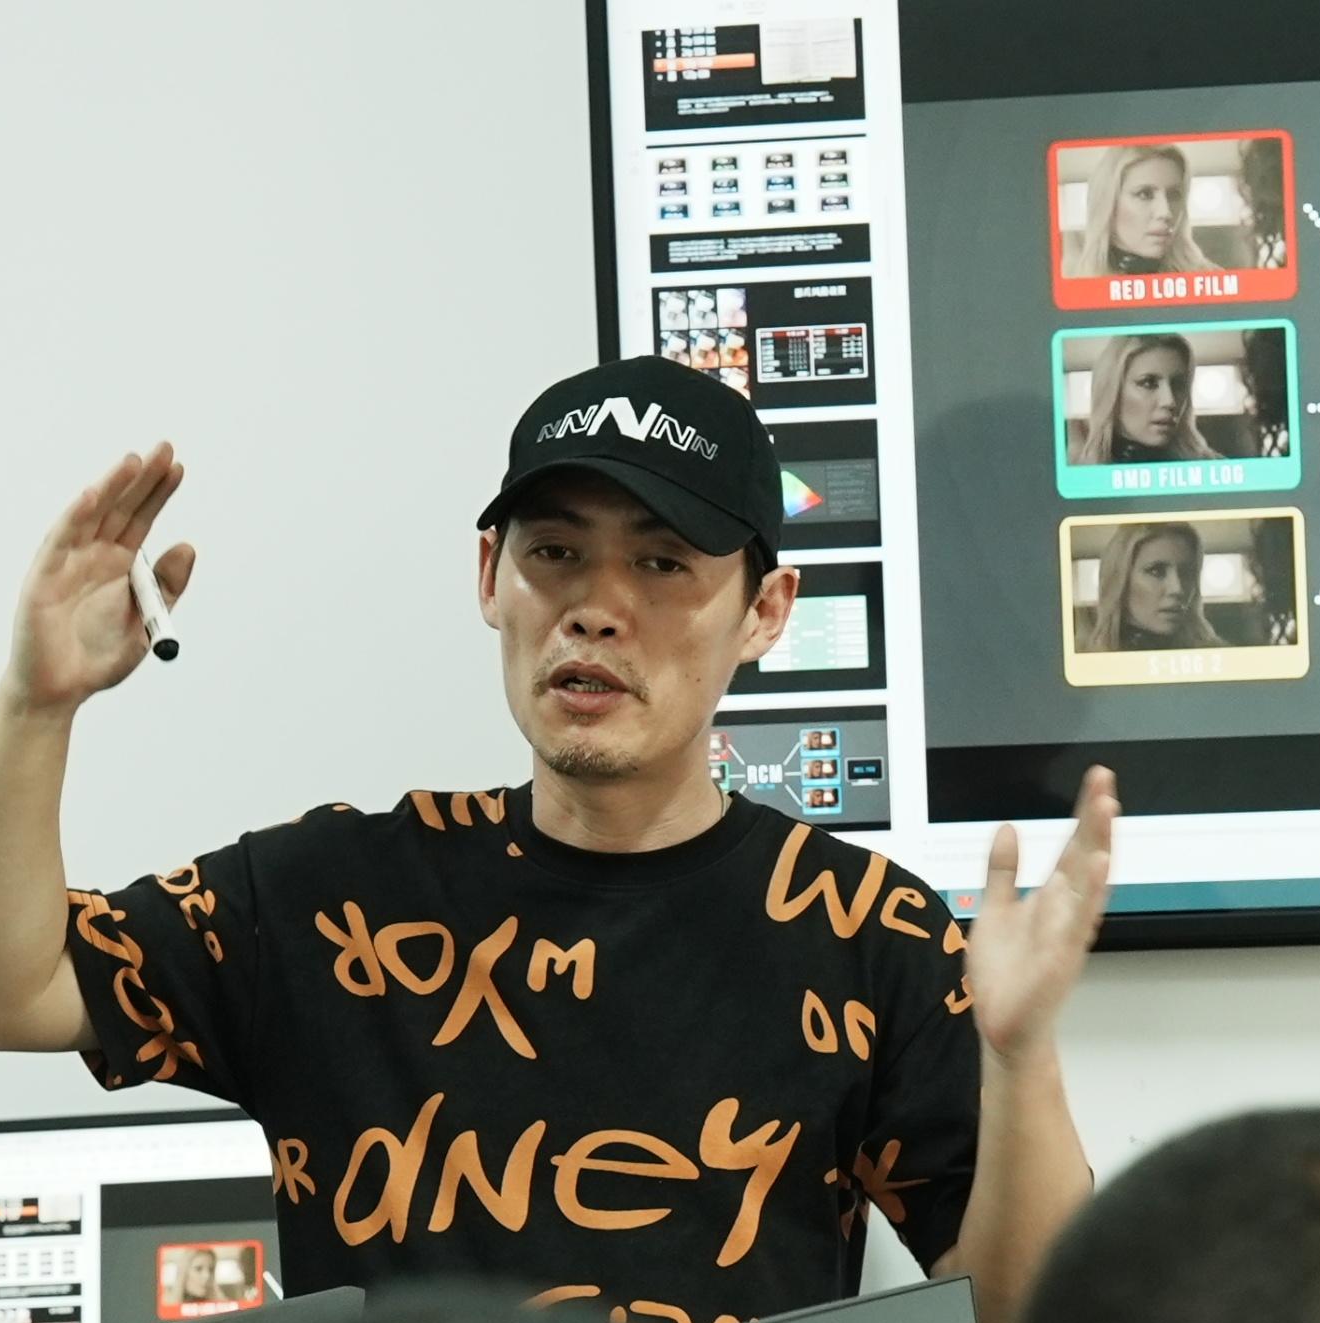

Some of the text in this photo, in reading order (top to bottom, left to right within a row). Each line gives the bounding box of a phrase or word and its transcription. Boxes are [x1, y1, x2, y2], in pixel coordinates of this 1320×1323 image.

[1109, 274, 1239, 301] RED LOG FILM
[1111, 465, 1245, 491] BMD FILM LOG
